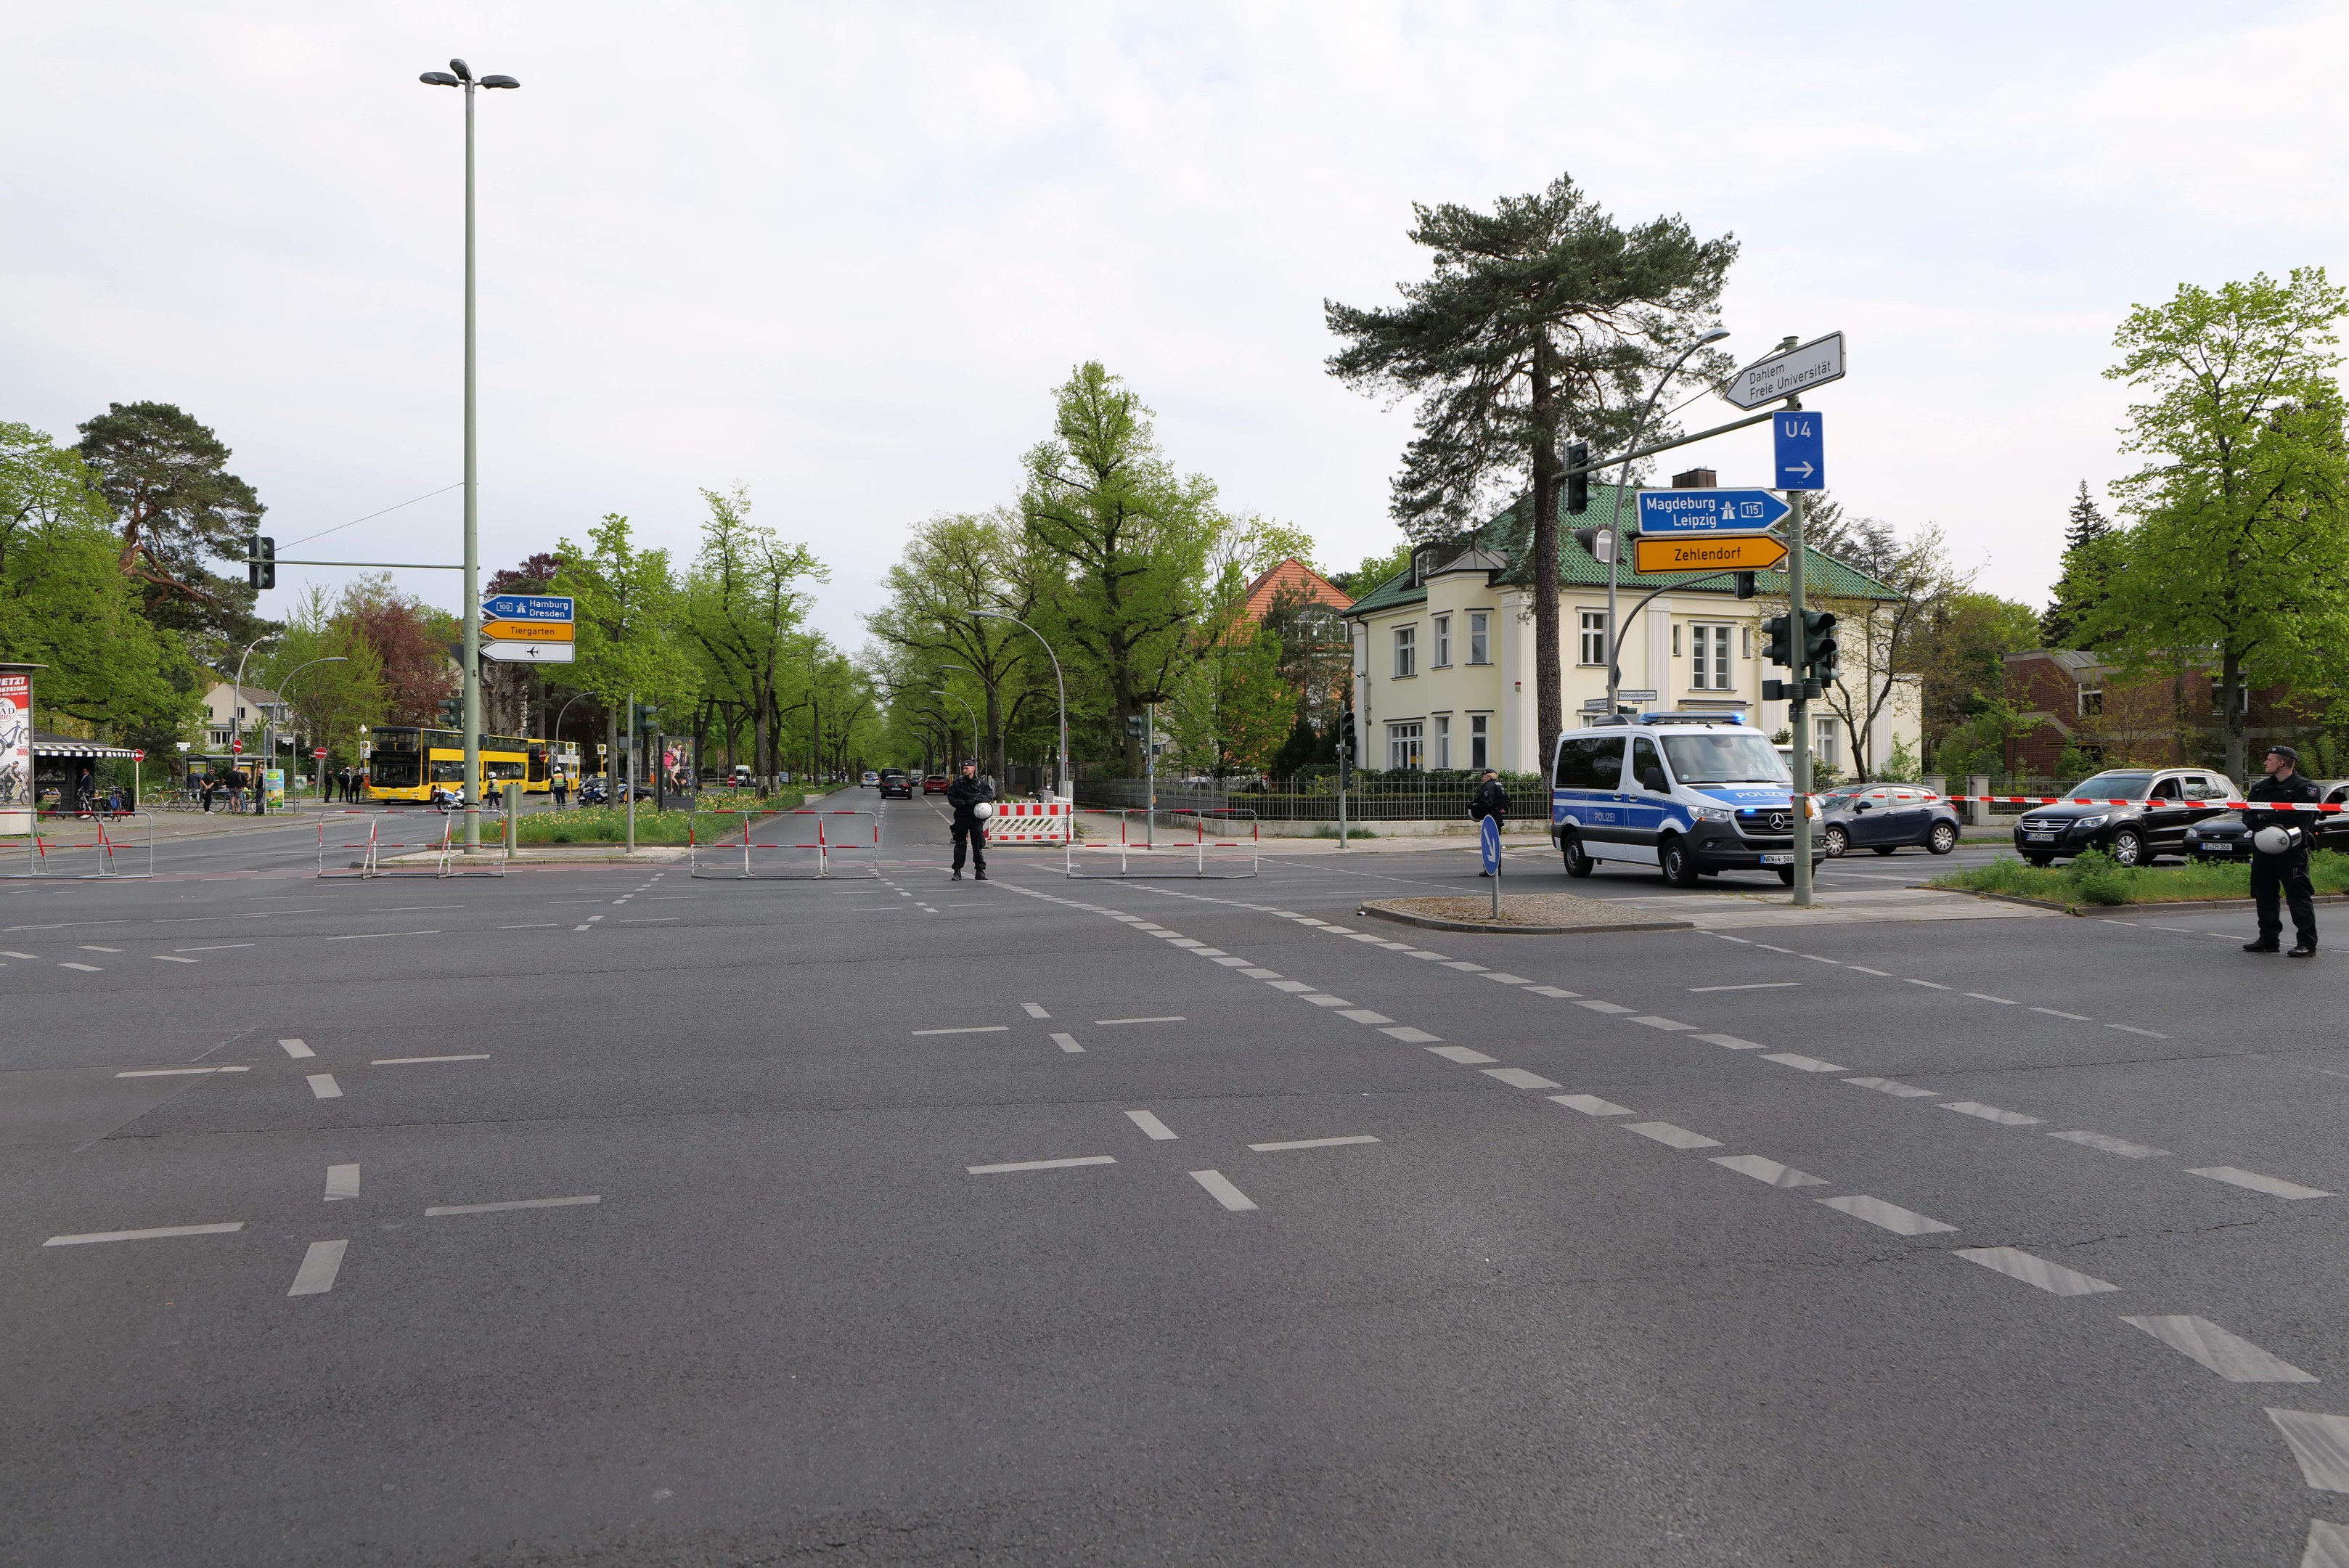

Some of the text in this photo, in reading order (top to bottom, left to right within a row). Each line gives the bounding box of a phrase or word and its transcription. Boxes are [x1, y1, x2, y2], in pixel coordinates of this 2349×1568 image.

[1749, 364, 1785, 385] Dahlem
[1750, 360, 1831, 400] Freie Universität
[1646, 497, 1715, 513] Magdeburg
[1745, 505, 1759, 515] 115
[1673, 513, 1717, 528] Leipzig
[1675, 547, 1741, 561] Zehlendorf
[529, 600, 568, 611] Hamburg
[529, 609, 565, 618] Dresden
[510, 626, 555, 637] Tiergarten
[0, 677, 25, 686] ETZT
[1594, 812, 1615, 822] POLIZEI
